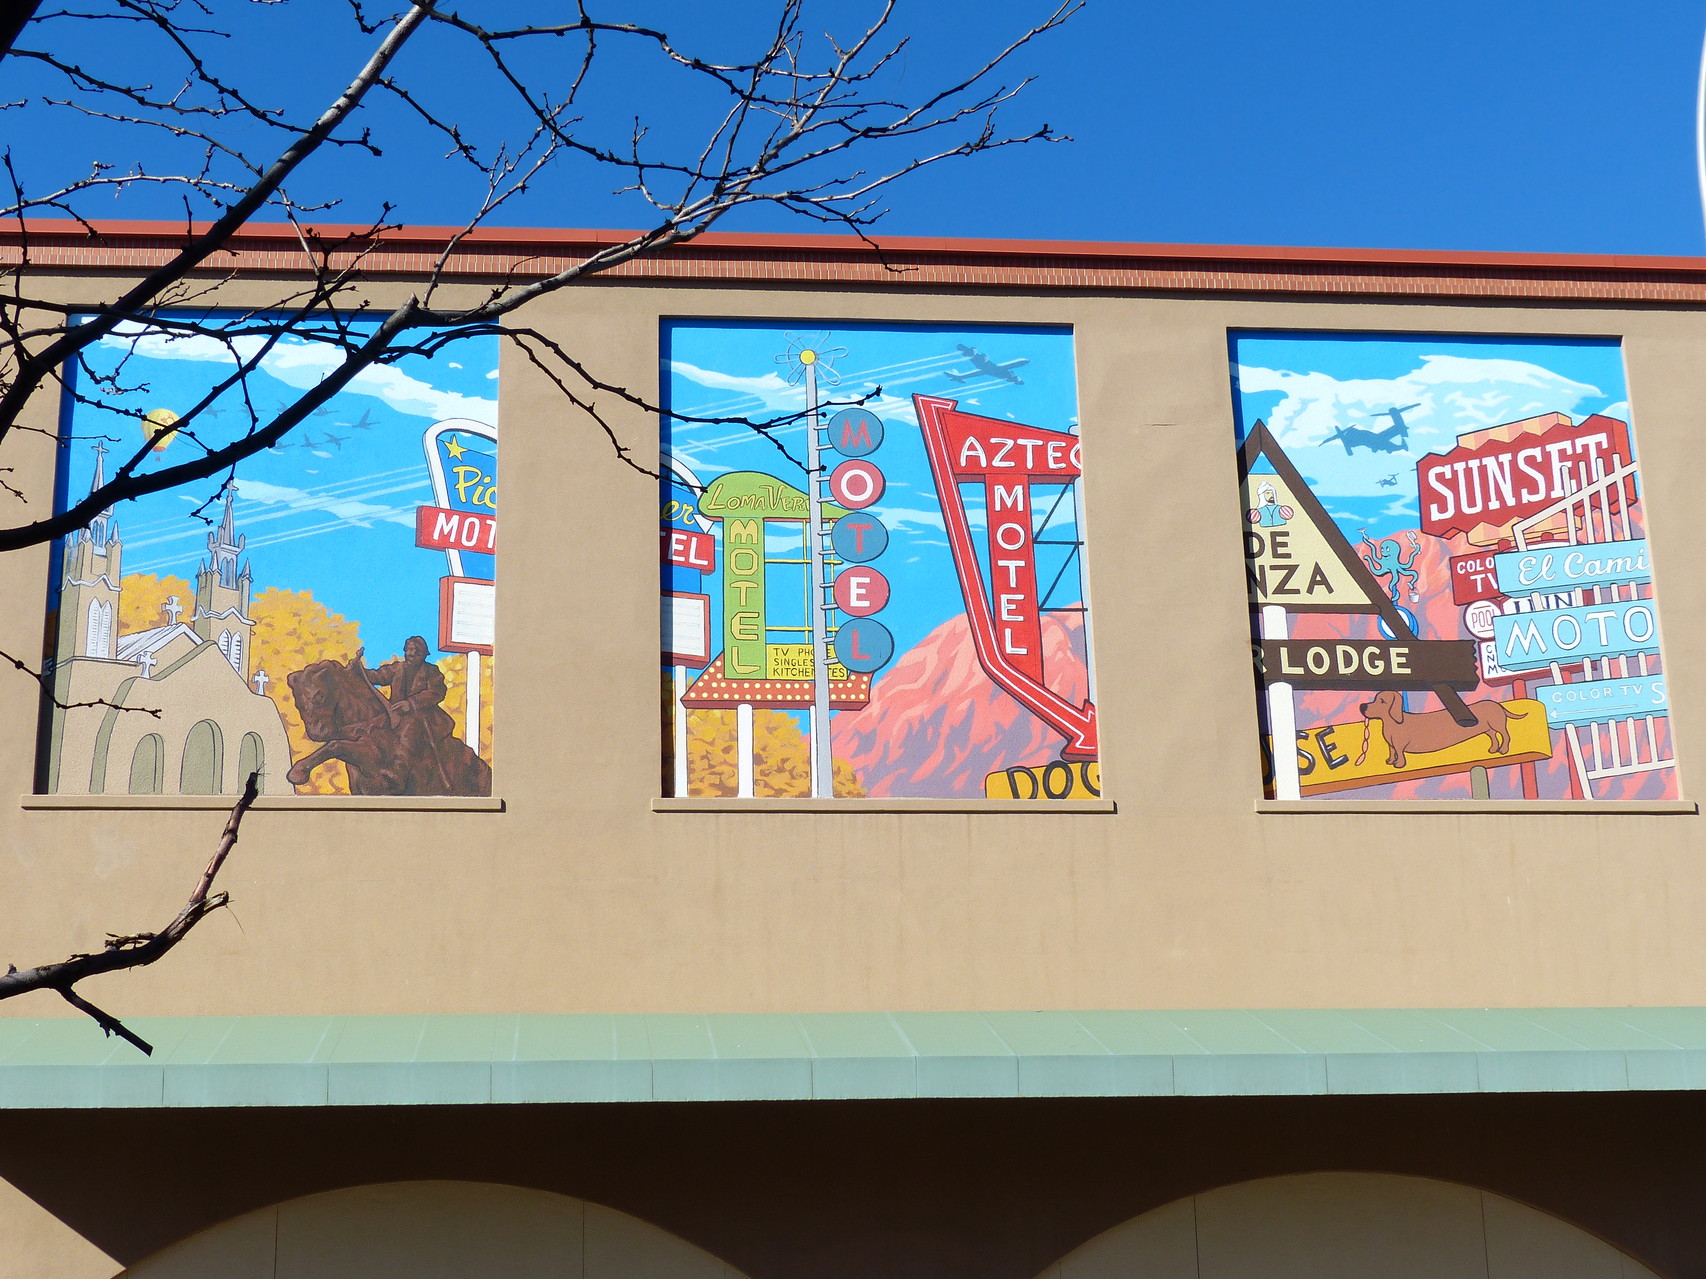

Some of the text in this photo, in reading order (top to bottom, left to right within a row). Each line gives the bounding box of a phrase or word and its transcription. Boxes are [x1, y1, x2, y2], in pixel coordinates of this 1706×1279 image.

[1427, 432, 1608, 522] SUNSET
[432, 512, 497, 549] MOT
[660, 531, 709, 566] EL
[840, 418, 878, 661] MOTEL
[1243, 531, 1292, 559] DE
[994, 485, 1028, 656] MOTEL
[1518, 548, 1651, 586] El Cami
[729, 518, 762, 675] MOTEL
[1505, 605, 1655, 659] MOTO
[773, 647, 790, 657] TV
[1279, 644, 1412, 677] LODGE
[1551, 687, 1613, 703] COLOR
[1620, 684, 1643, 696] TV
